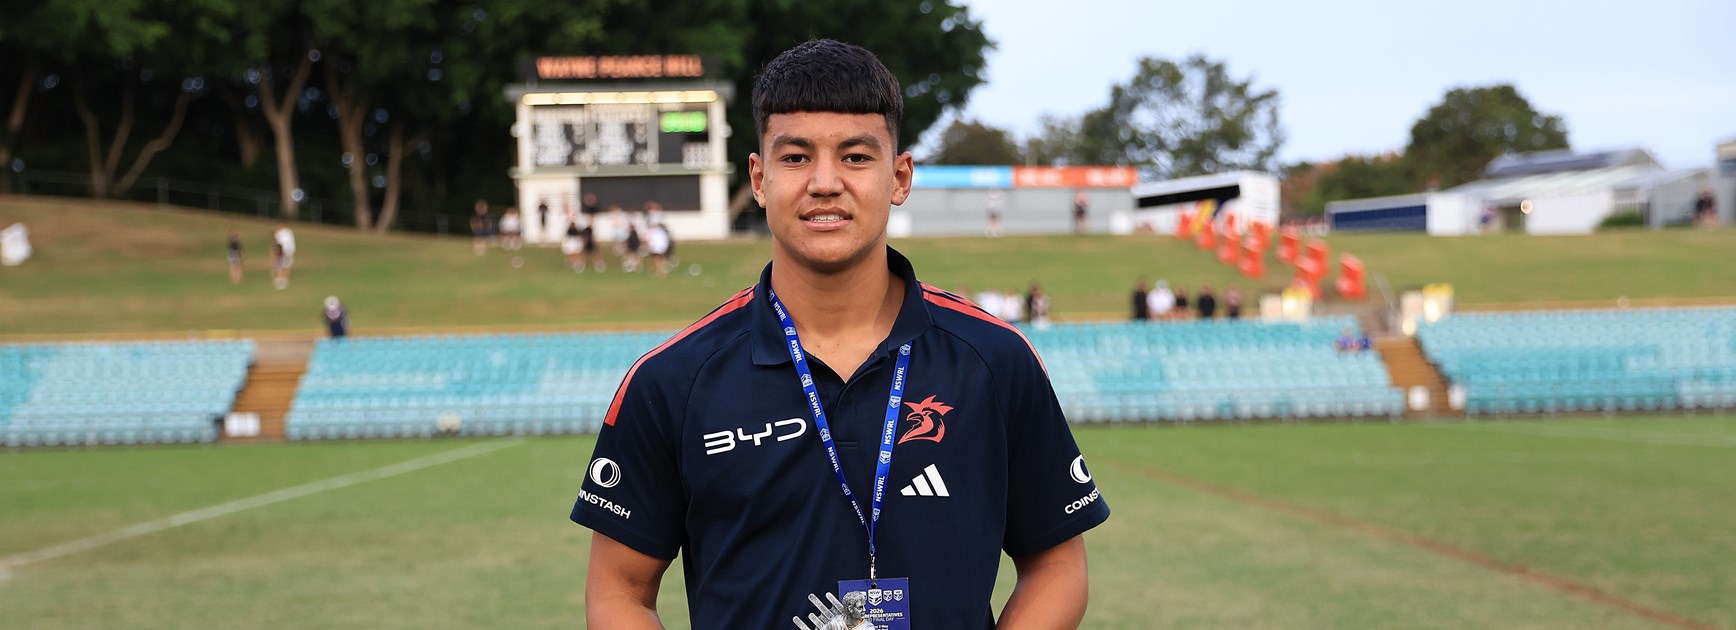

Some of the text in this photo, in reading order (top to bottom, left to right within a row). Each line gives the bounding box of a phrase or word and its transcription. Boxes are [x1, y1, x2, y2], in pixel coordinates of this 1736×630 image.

[773, 301, 787, 321] NSWRL
[790, 340, 803, 363] NSWRL
[894, 366, 905, 391] NSWRL
[808, 391, 822, 418] NSWRL
[703, 418, 807, 455] BYD
[884, 419, 895, 445] NSWRL
[827, 446, 840, 473] NSWRL
[875, 476, 885, 502] NSWRL
[851, 500, 865, 525] NSWRL
